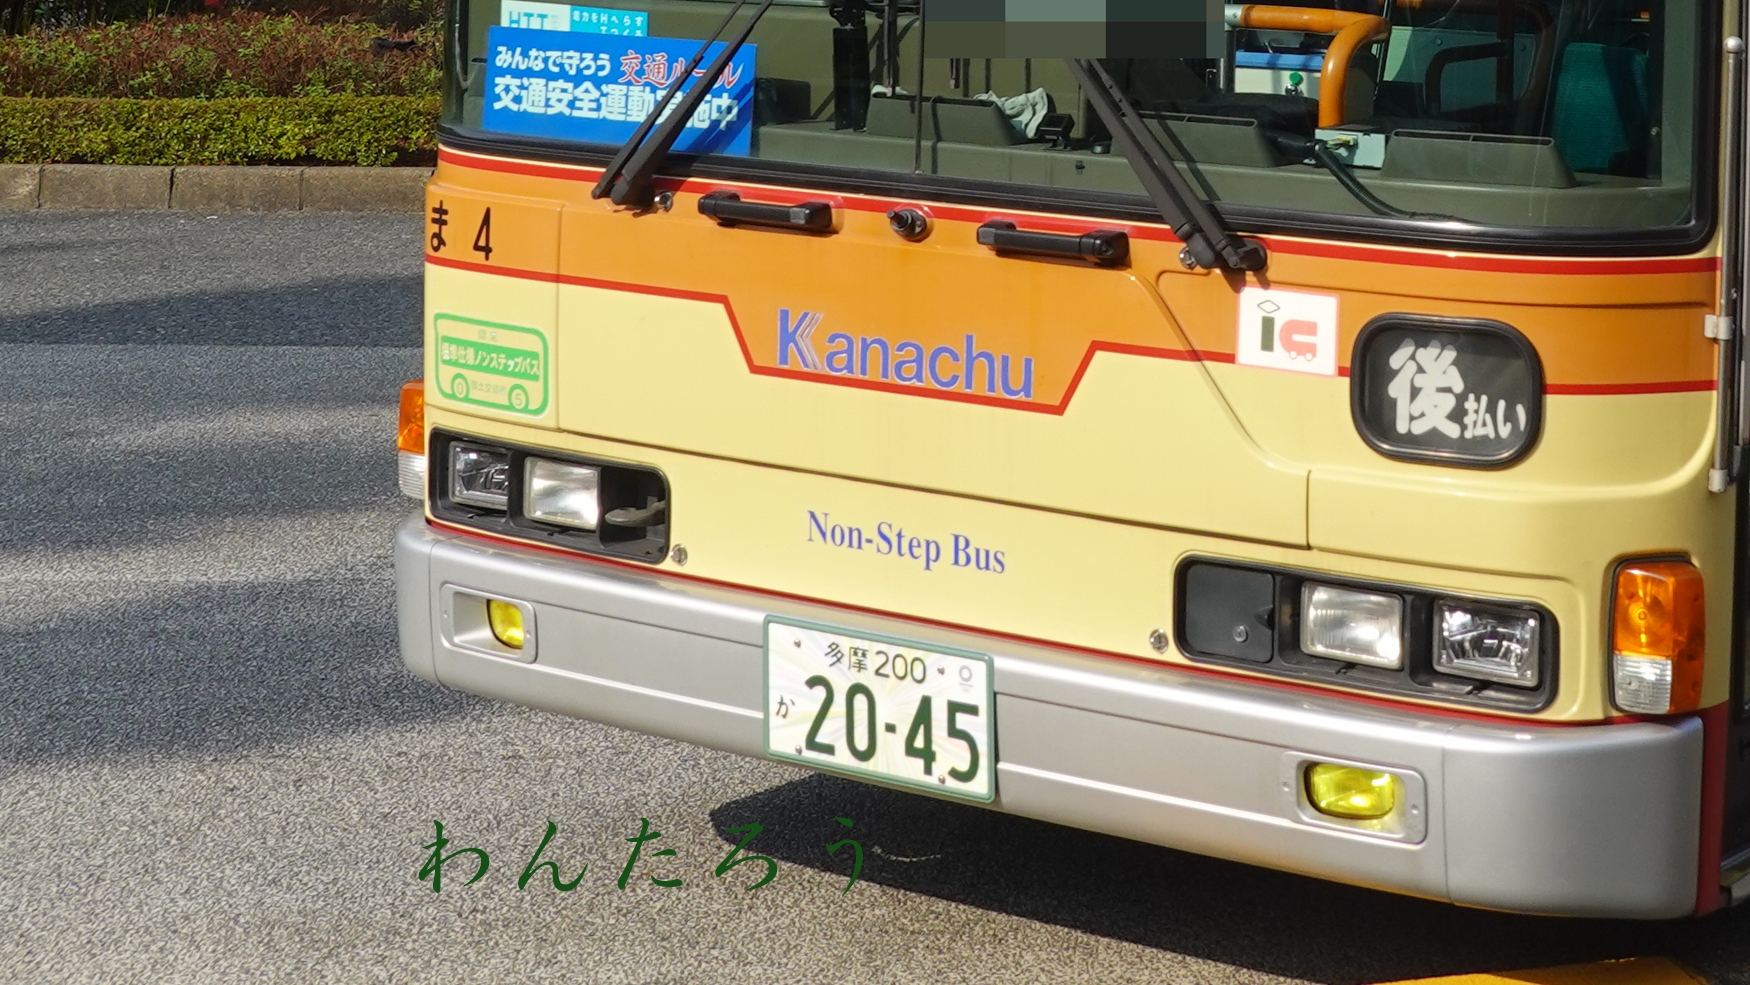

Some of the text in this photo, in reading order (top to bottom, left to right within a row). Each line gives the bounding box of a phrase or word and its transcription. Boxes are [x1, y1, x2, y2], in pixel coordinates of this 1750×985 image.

[495, 46, 745, 89] みんなで守ろう 交通ルール
[431, 199, 493, 261] ま 4
[777, 308, 1035, 400] Kanachu
[514, 393, 523, 407] 5
[1387, 338, 1527, 439] 後払い
[806, 508, 1007, 575] Non-Step Bus
[775, 674, 980, 784] か 20-45
